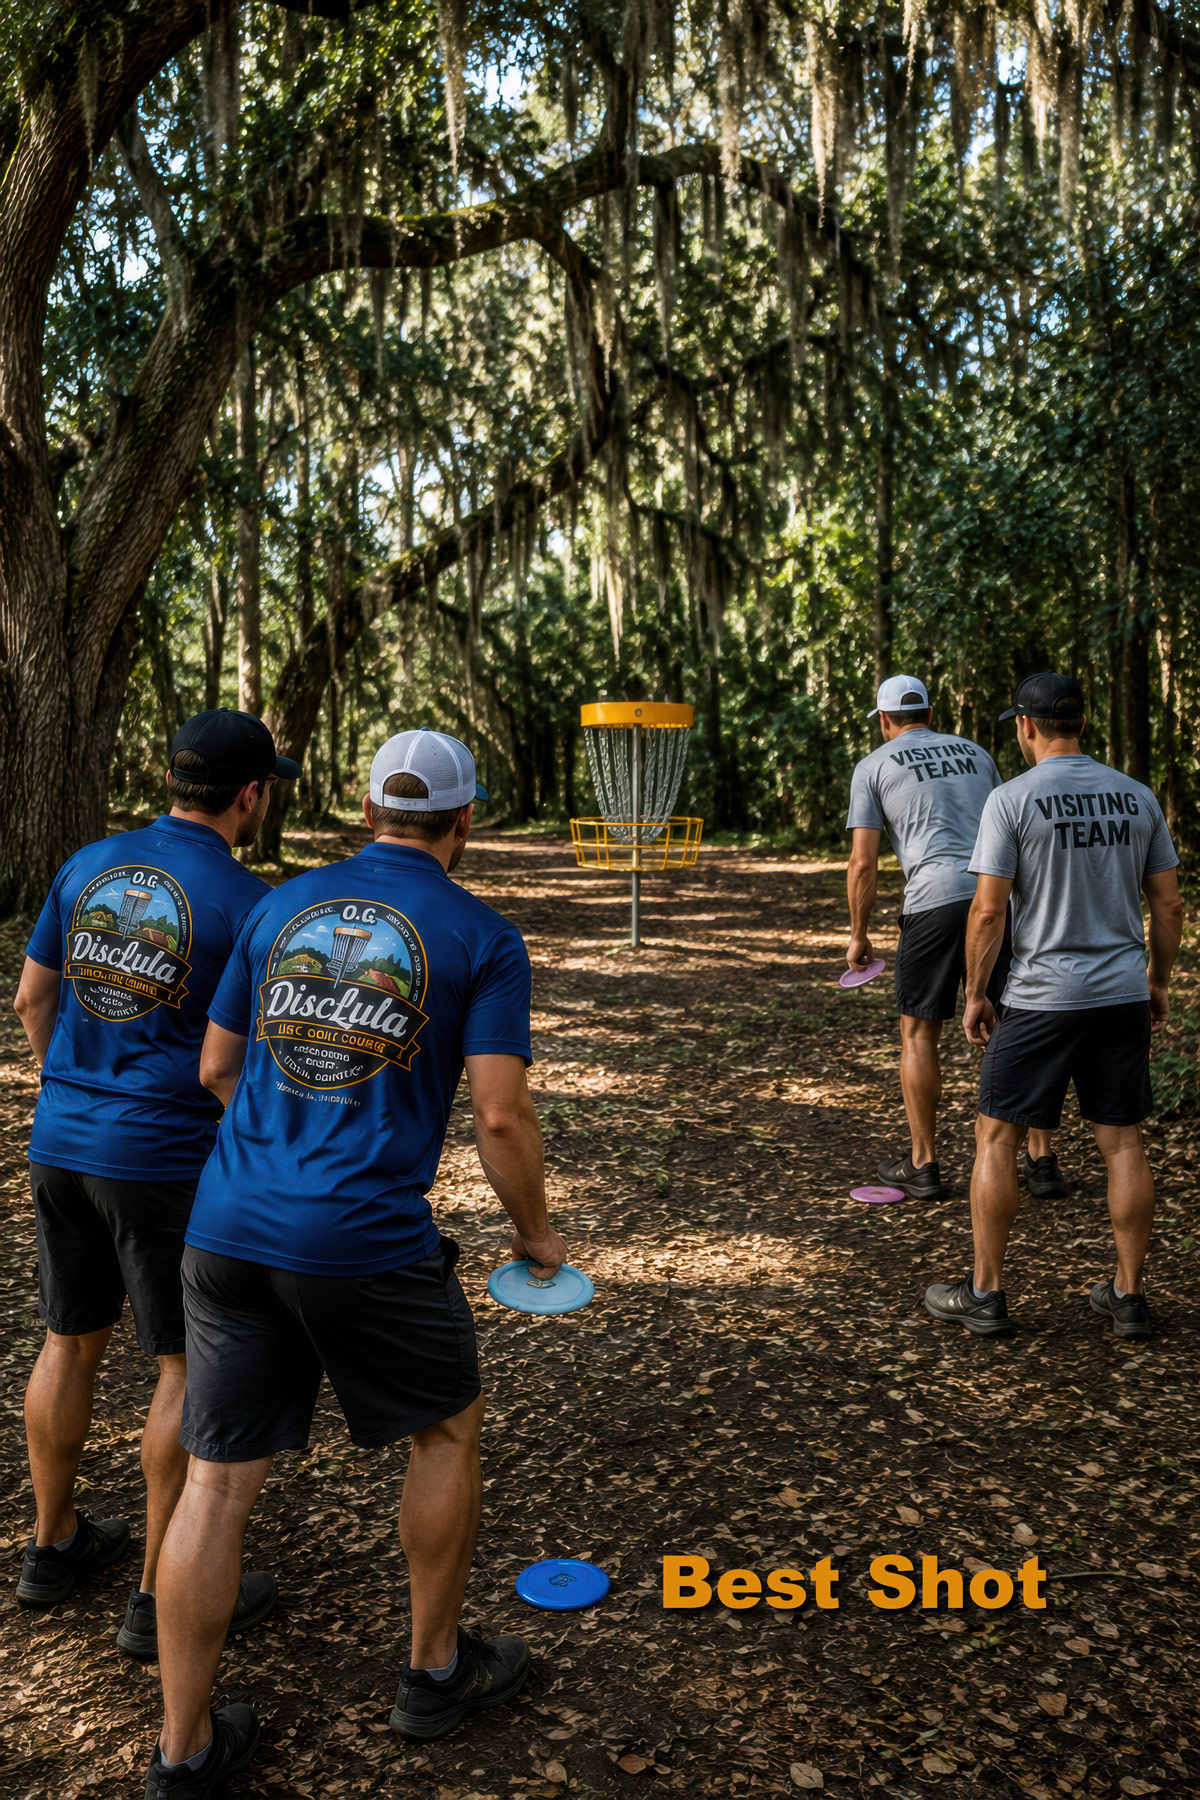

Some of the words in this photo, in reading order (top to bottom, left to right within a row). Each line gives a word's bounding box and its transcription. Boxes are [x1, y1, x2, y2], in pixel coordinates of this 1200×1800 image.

[889, 743, 977, 766] VISITING
[908, 757, 978, 782] TEAM
[1035, 792, 1139, 820] VISITING
[1054, 820, 1131, 850] TEAM
[72, 931, 177, 984] DiscLula
[266, 980, 409, 1037] DiscLula
